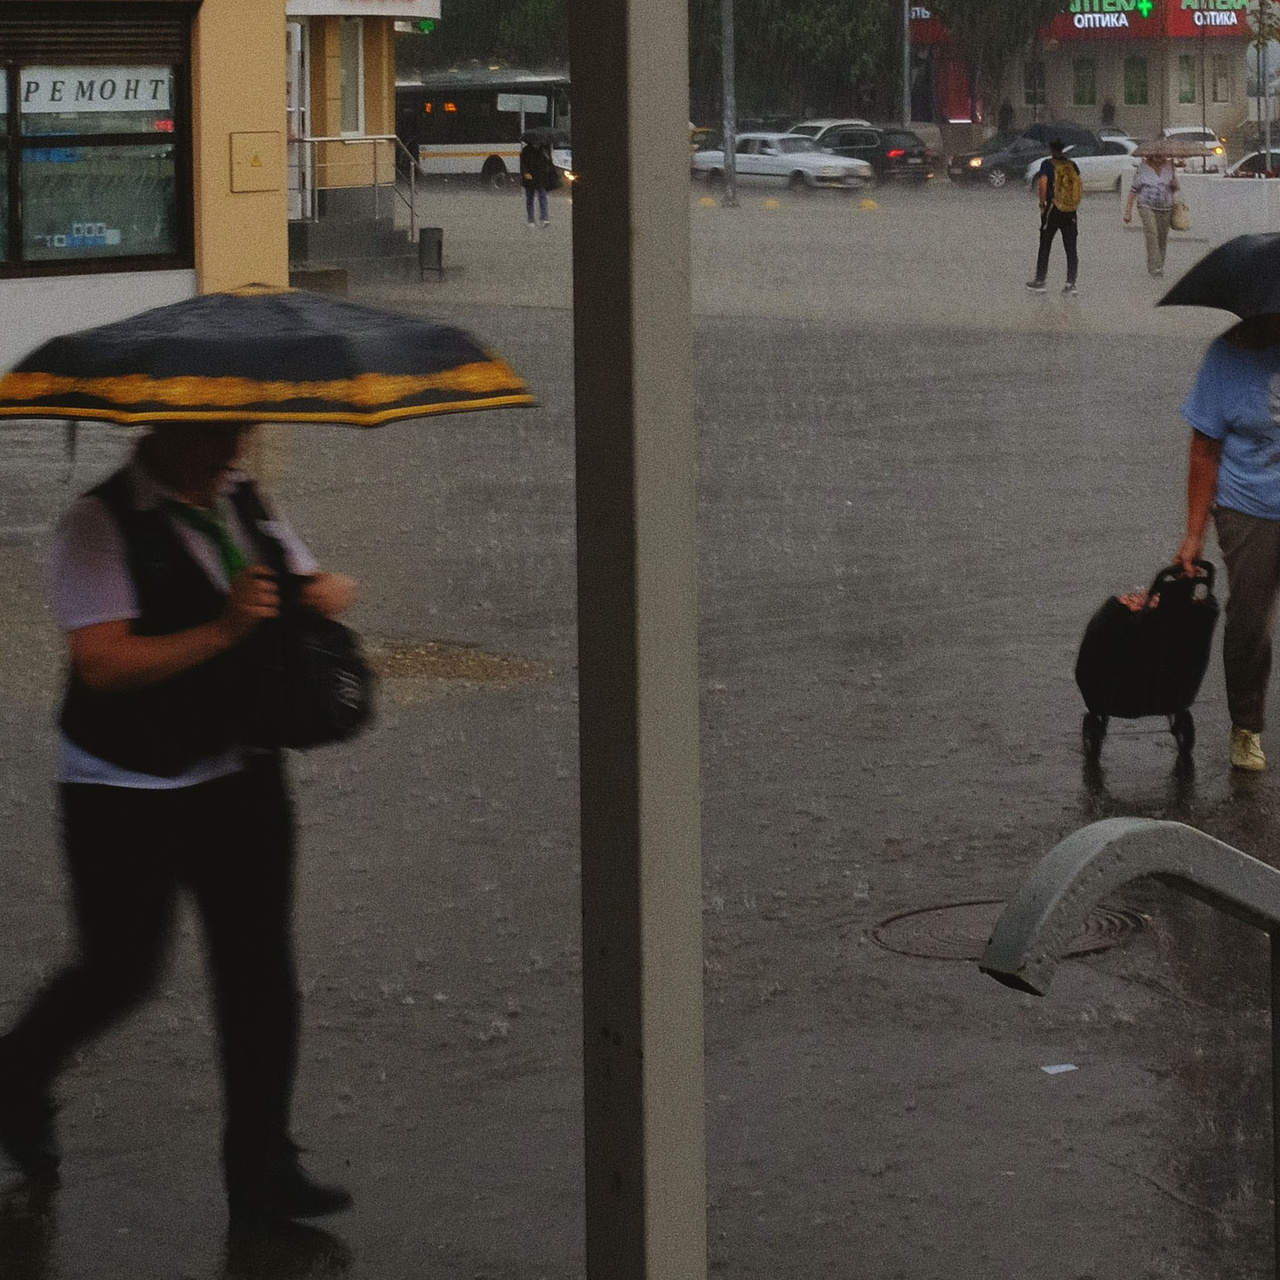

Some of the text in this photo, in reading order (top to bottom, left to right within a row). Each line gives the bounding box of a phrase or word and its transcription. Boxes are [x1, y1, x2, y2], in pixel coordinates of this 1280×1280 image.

[1073, 13, 1129, 28] ОПТИКА
[1193, 11, 1238, 26] ОПТИКА
[23, 79, 165, 103] РЕМОНТ
